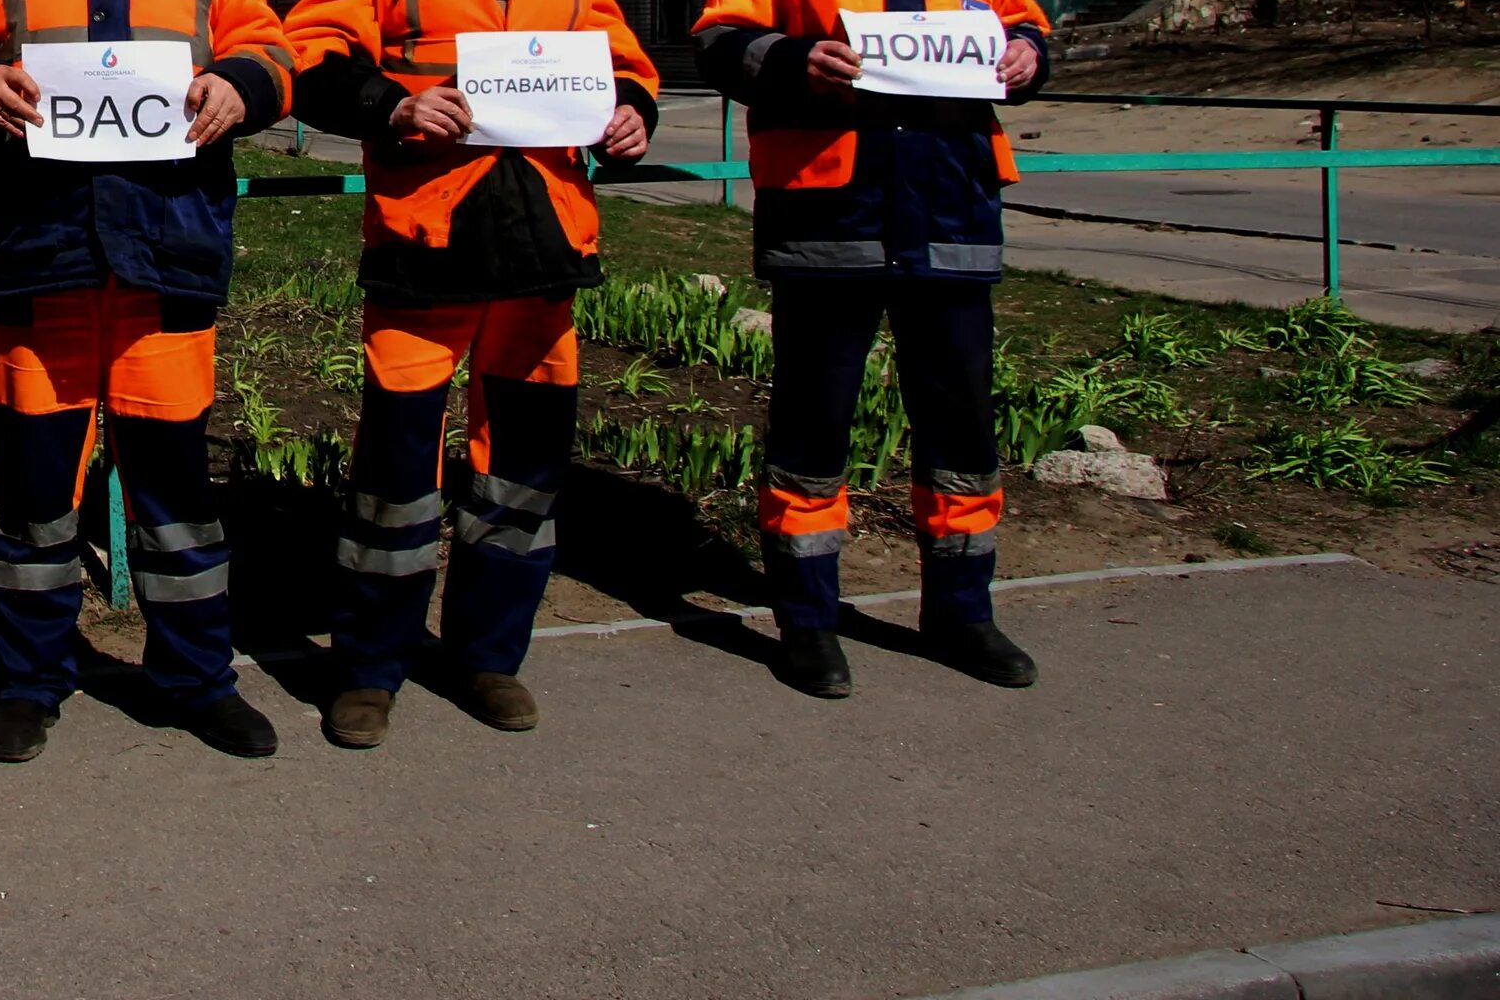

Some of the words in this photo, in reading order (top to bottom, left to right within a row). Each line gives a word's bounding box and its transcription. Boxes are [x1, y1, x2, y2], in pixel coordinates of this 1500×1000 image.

[858, 34, 997, 67] ДОМА!
[84, 69, 136, 77] РОСВОДОКАНАЛ
[465, 74, 608, 95] ОСТАВАЙТЕСЬ
[50, 94, 171, 139] ВАС
